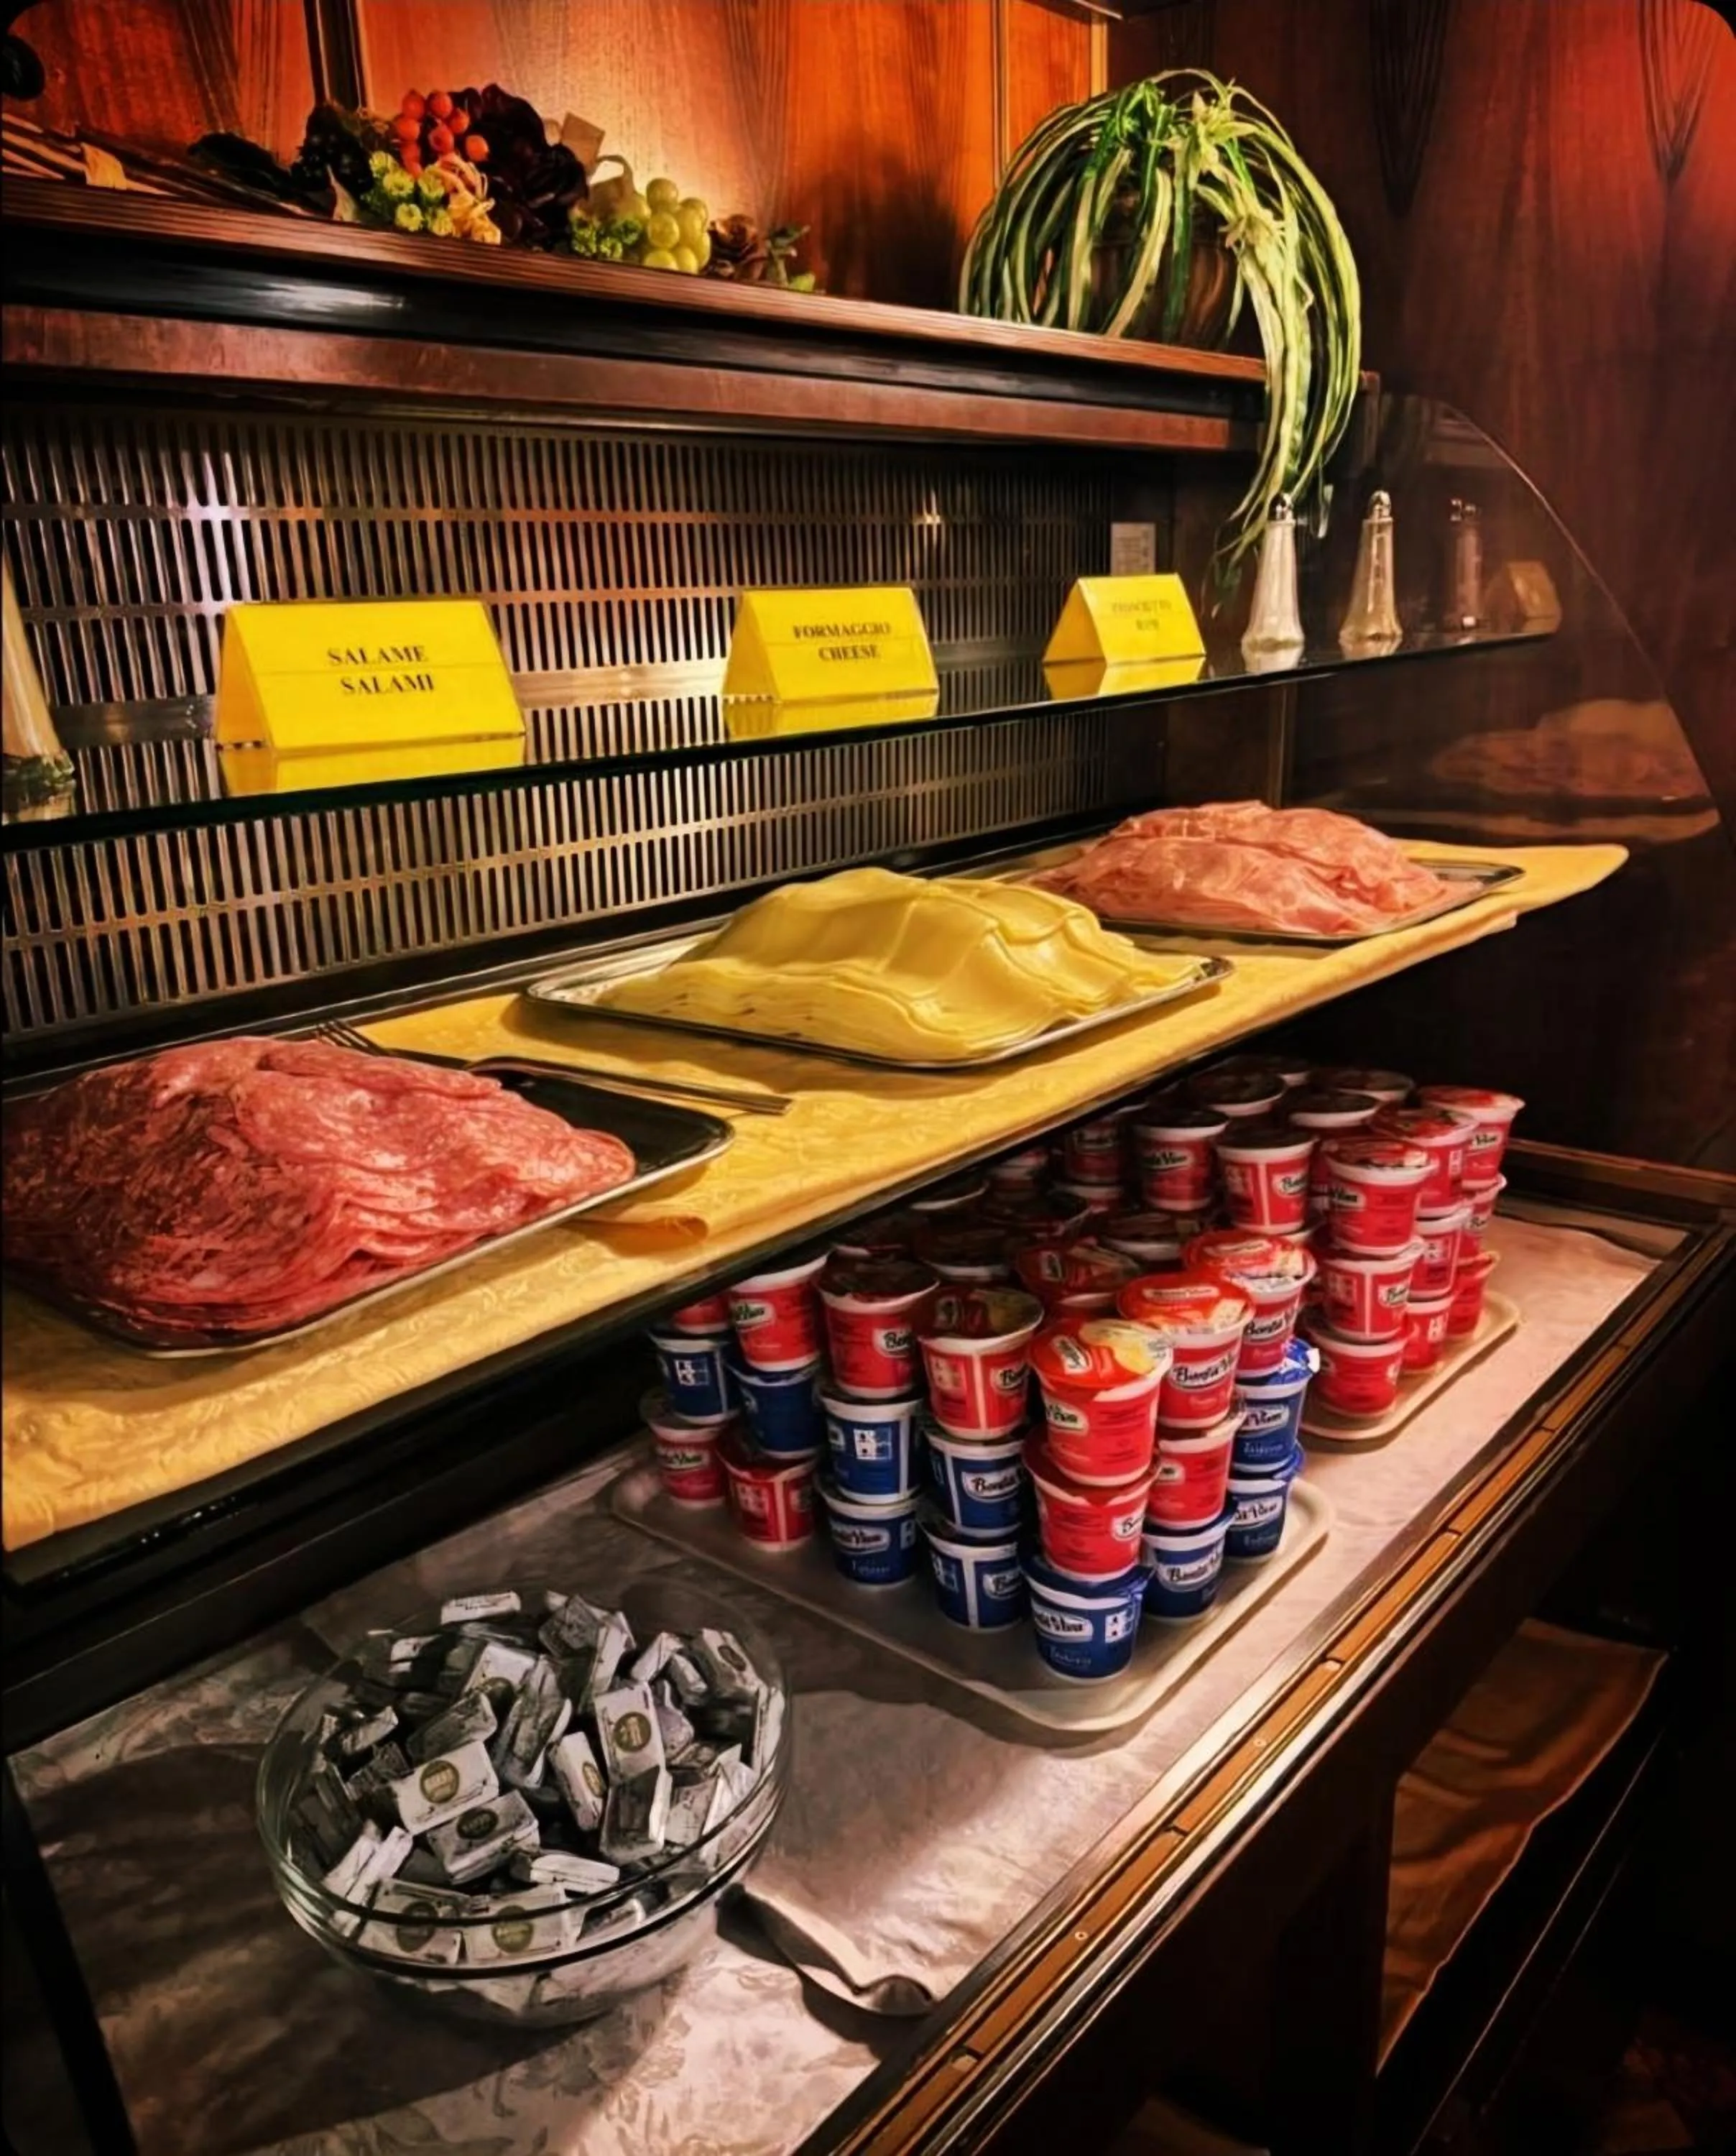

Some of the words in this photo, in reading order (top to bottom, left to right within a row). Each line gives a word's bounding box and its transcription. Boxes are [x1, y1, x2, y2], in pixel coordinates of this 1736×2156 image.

[793, 620, 892, 640] FORMAGGIO
[327, 645, 430, 665] SALAME
[818, 644, 879, 662] CHEESE
[340, 673, 434, 696] SALAMI
